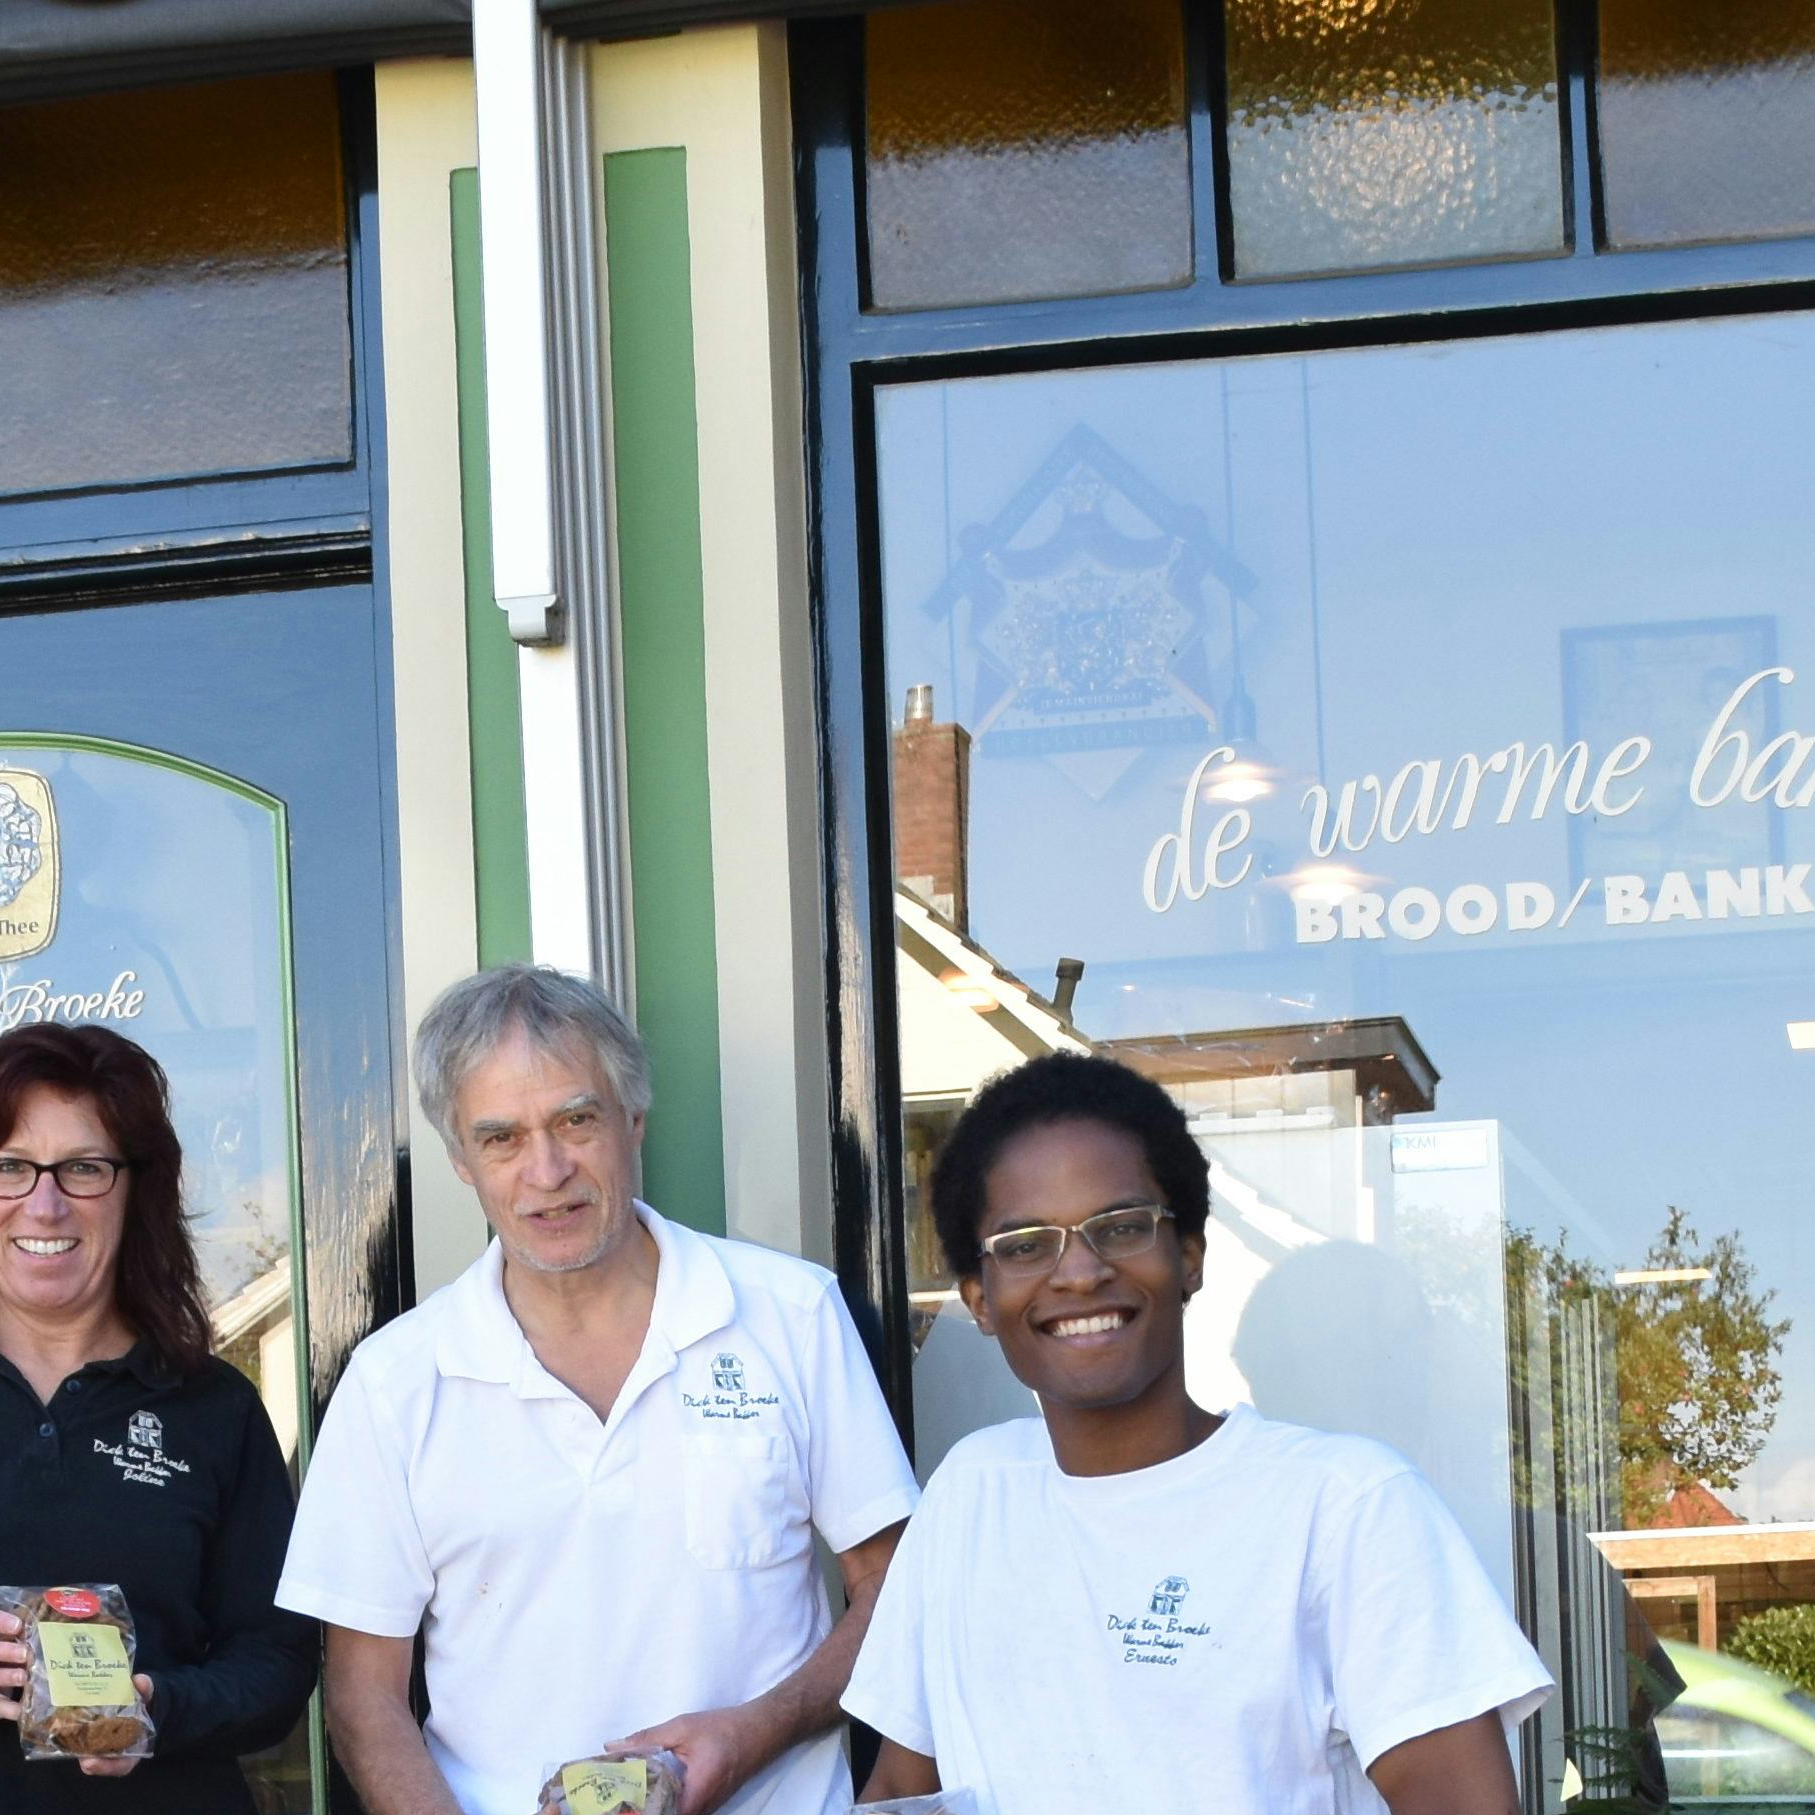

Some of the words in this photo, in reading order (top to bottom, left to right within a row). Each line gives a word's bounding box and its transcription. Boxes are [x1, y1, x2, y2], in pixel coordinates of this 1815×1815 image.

[1143, 746, 1252, 912] de
[1300, 735, 1652, 858] warme
[682, 1393, 711, 1407] Dick
[93, 1439, 124, 1456] Dick
[1107, 1614, 1136, 1631] Dick
[1142, 1618, 1162, 1631] ten
[1124, 1648, 1177, 1666] Ernesto
